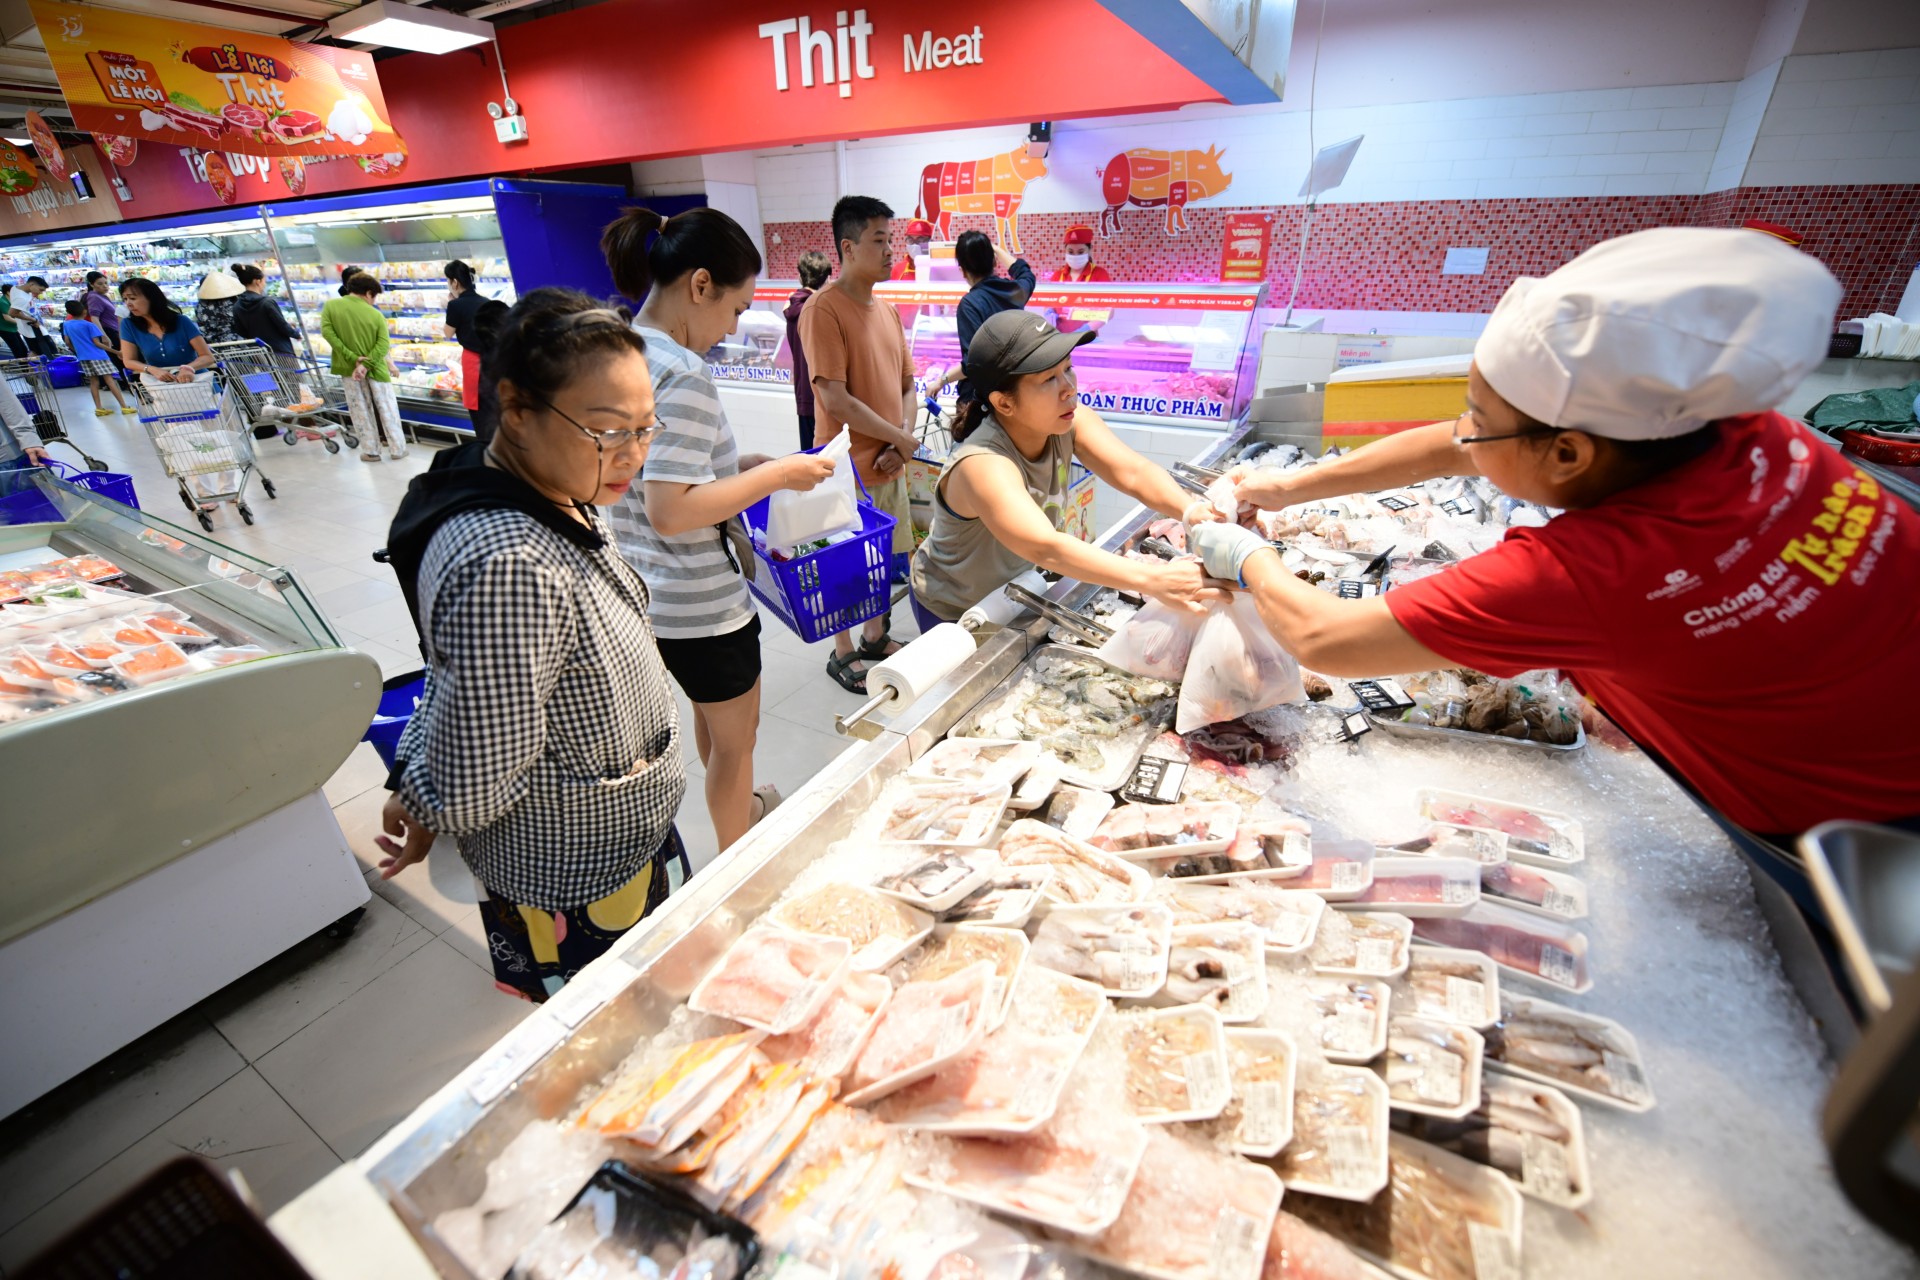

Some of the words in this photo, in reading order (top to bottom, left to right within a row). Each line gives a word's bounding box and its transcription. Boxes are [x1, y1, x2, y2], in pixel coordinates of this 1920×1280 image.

[211, 44, 242, 71] Lễ
[245, 52, 277, 80] Hội
[758, 9, 875, 98] Thịt
[903, 25, 984, 73] Meat
[108, 64, 147, 82] MỘT
[109, 80, 131, 98] LỄ
[132, 86, 165, 103] HỘI
[215, 73, 286, 113] Thịt
[747, 367, 772, 379] SINH
[774, 370, 790, 381] AN
[1121, 396, 1167, 414] THỰC
[1171, 397, 1222, 417] PHẨM
[1683, 582, 1767, 626] Chúng
